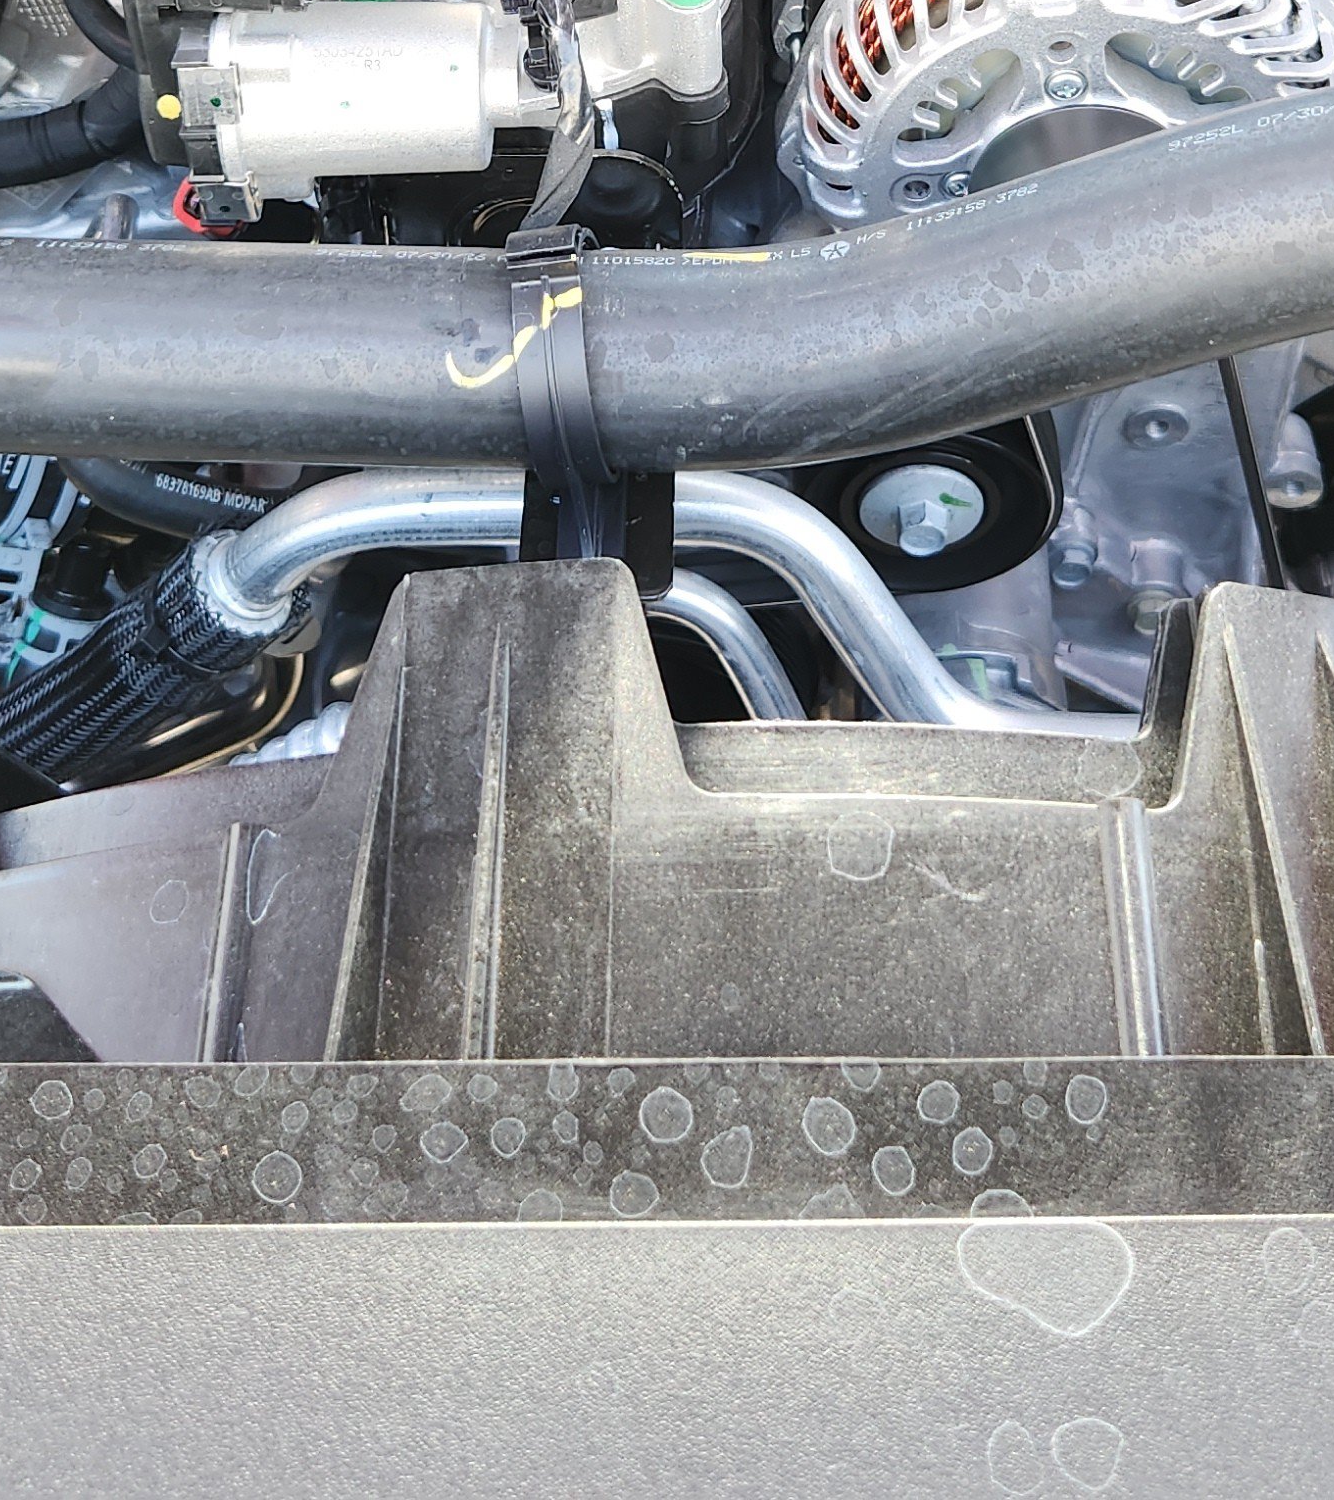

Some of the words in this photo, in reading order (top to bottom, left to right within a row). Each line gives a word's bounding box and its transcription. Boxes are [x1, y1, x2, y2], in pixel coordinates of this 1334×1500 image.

[1167, 124, 1245, 152] 97252L
[590, 254, 676, 267] 1101582C
[995, 183, 1039, 204] 3782
[155, 471, 221, 503] 68378169AB
[223, 490, 268, 514] MOPAR
